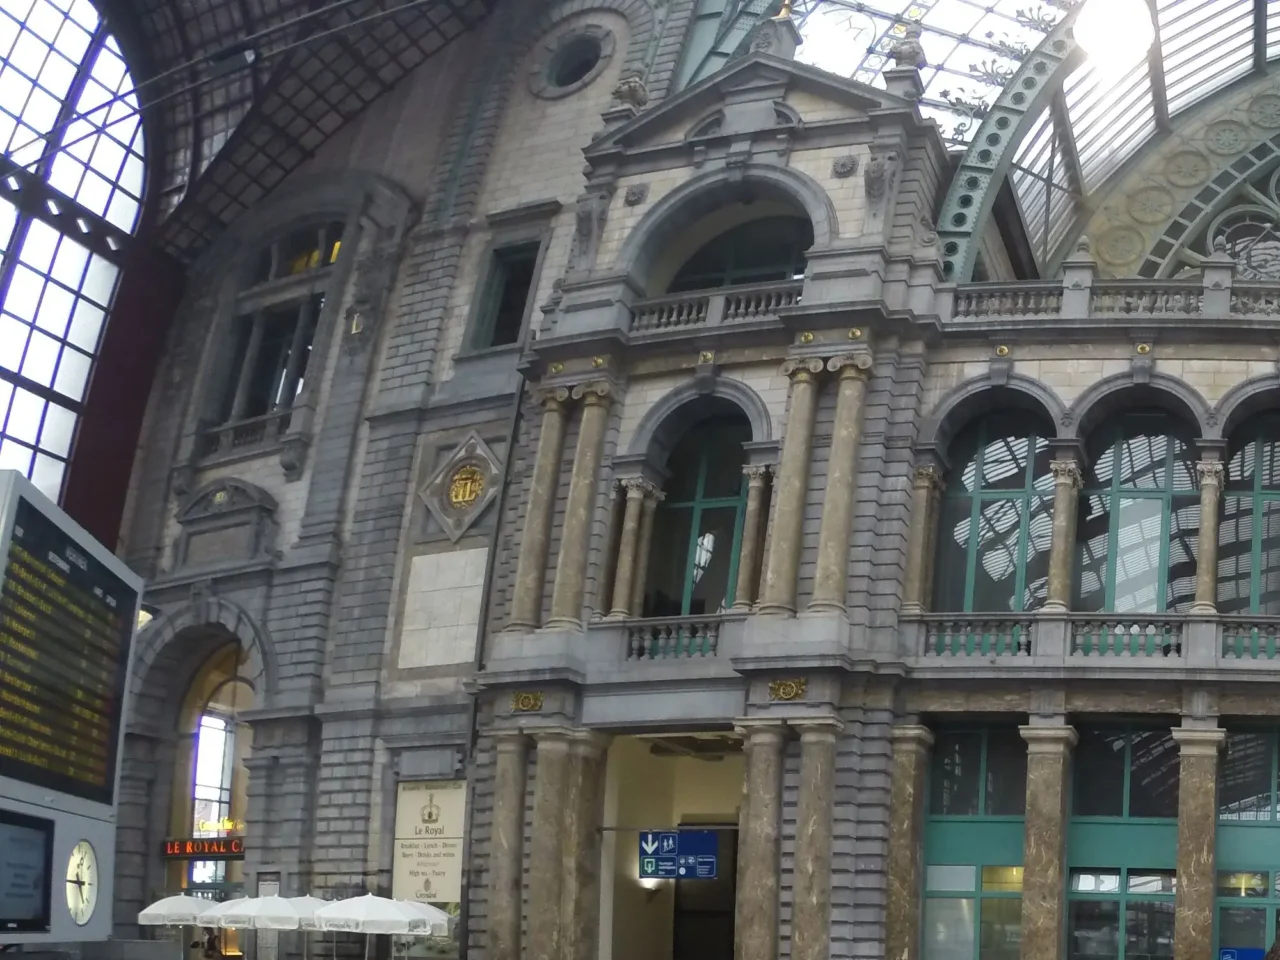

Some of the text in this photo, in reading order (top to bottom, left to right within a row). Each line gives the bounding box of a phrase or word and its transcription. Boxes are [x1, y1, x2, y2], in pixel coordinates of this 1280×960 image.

[414, 825, 445, 836] Le Royal
[167, 841, 180, 854] LE
[186, 840, 226, 853] ROYAL
